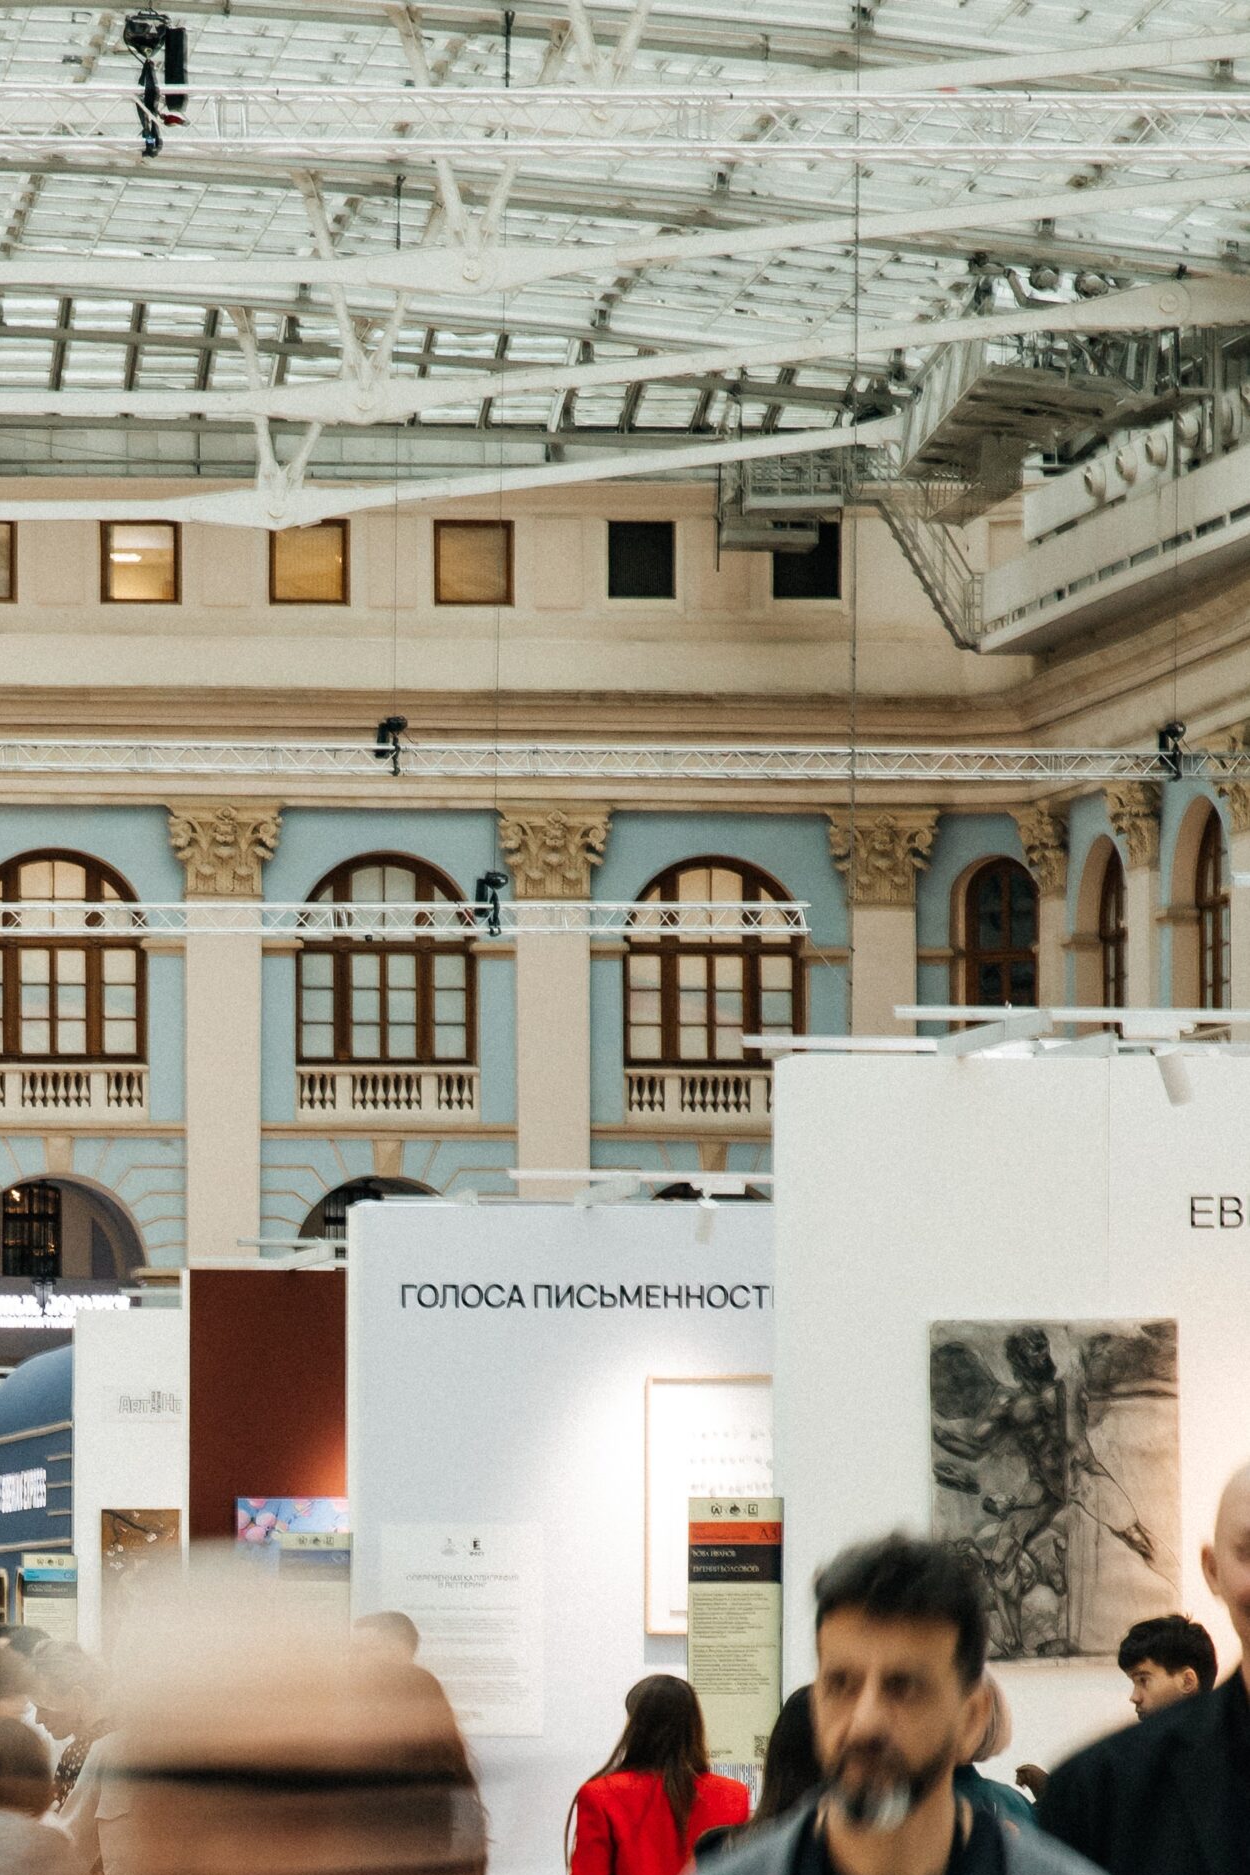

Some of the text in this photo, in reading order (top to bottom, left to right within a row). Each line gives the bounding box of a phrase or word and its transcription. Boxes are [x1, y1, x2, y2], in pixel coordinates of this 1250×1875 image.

[1190, 1195, 1250, 1230] ЕВ
[400, 1282, 775, 1310] ГОЛОСА ПИСЬМЕННОСТ
